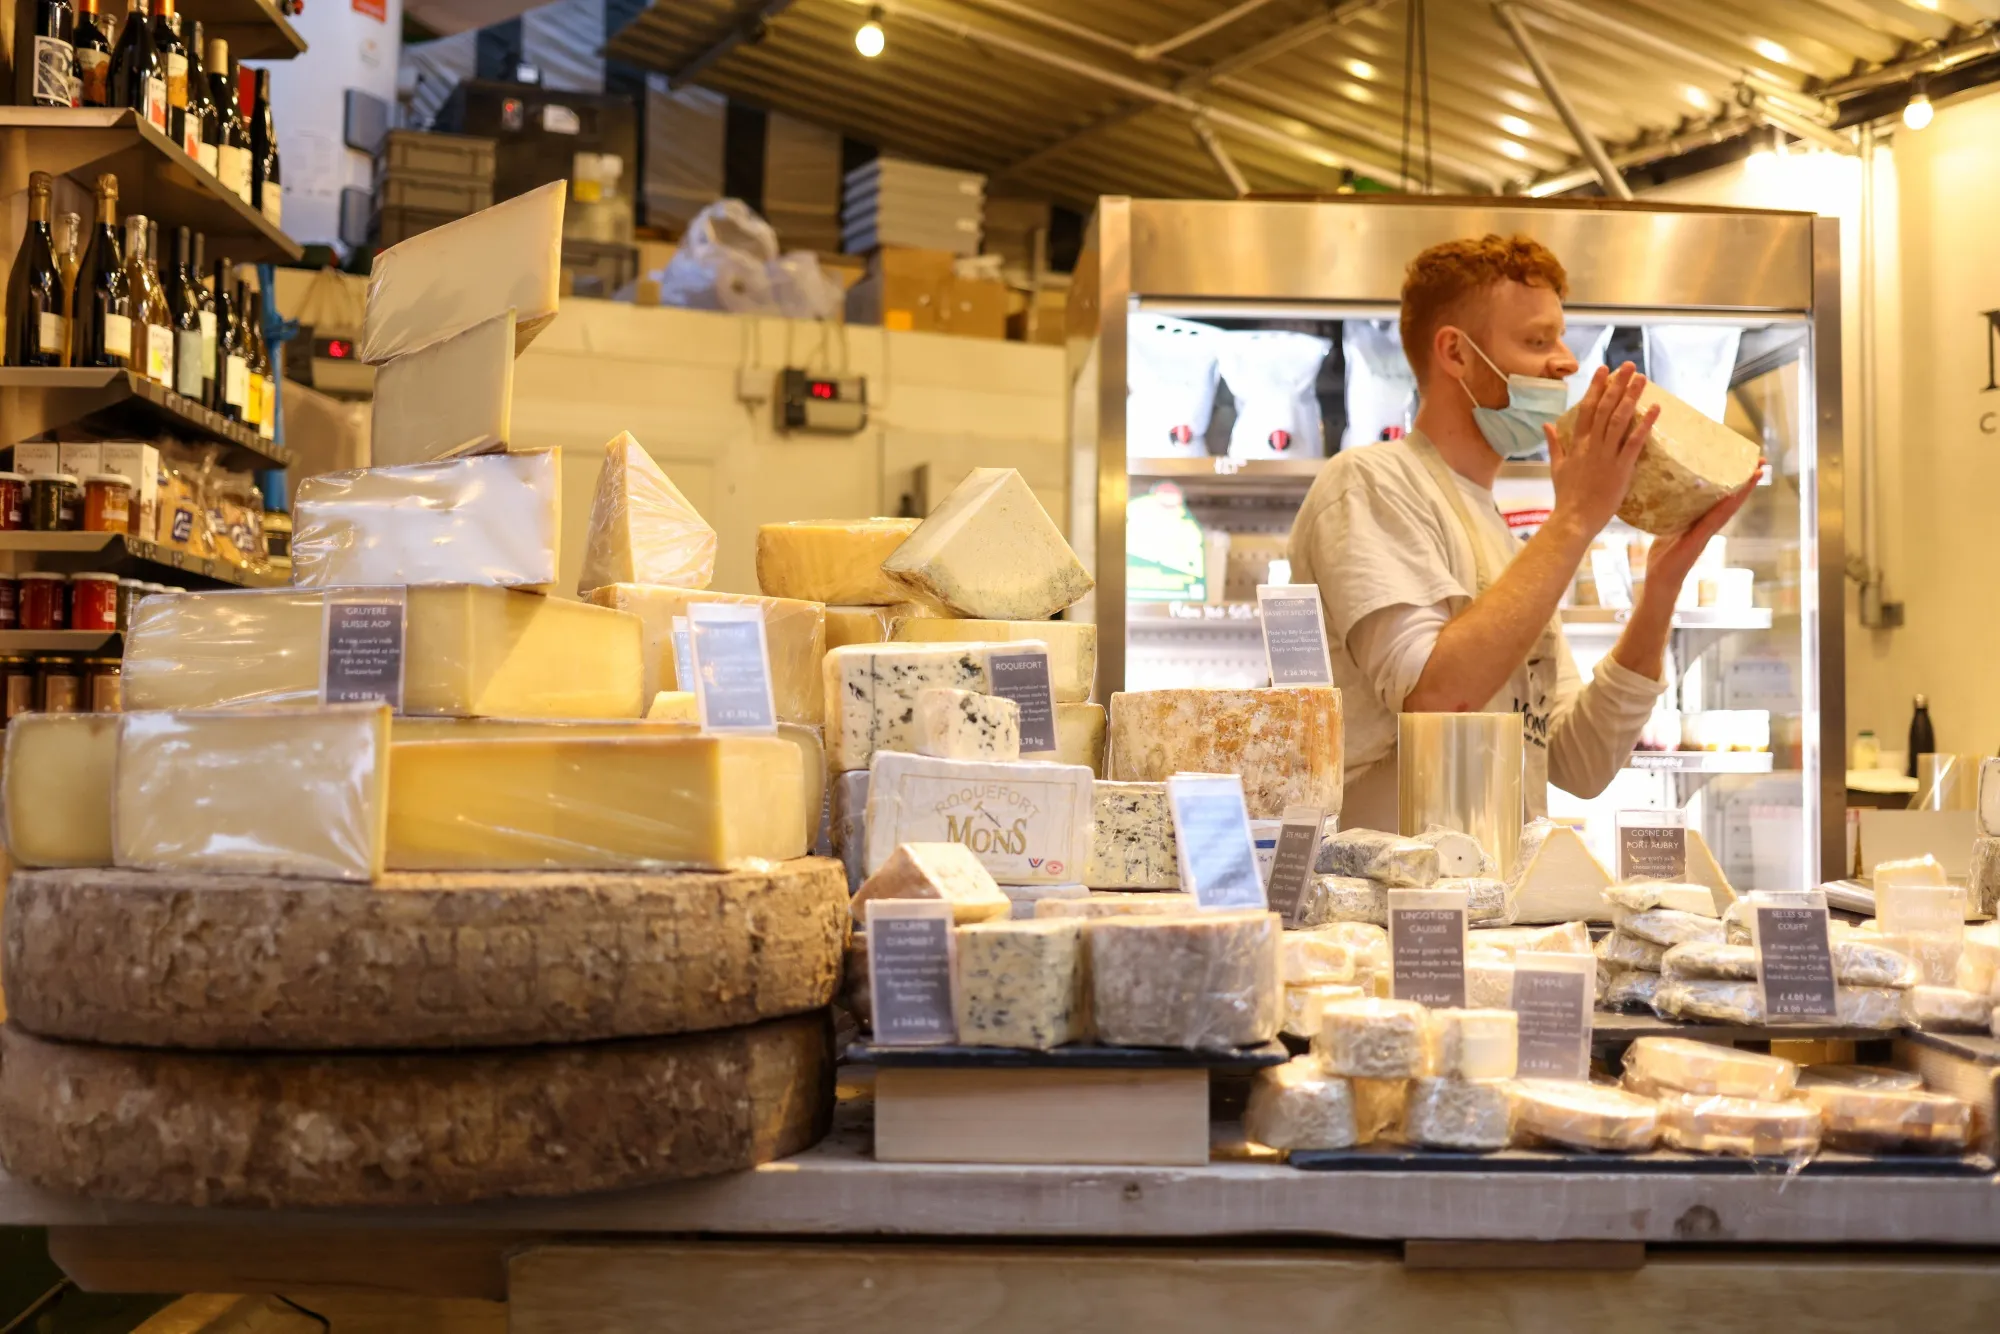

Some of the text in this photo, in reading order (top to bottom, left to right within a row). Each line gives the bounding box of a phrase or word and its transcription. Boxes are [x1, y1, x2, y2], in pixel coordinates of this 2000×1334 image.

[346, 606, 388, 616] GRUYERE
[341, 620, 392, 629] SUISSE AOP
[995, 661, 1042, 672] ROQUEFORT
[932, 785, 1040, 819] ROQUEFORT
[946, 814, 1028, 855] MONS
[1631, 829, 1674, 837] COSNE DE
[1626, 841, 1679, 849] PORT AUBRY
[1400, 911, 1455, 921] LINGOT DES
[1772, 911, 1813, 919] SELLES SUR
[1408, 924, 1448, 934] CAUSSES
[1777, 923, 1808, 932] COUFFY
[1805, 993, 1822, 1001] half
[1803, 1006, 1827, 1014] whole
